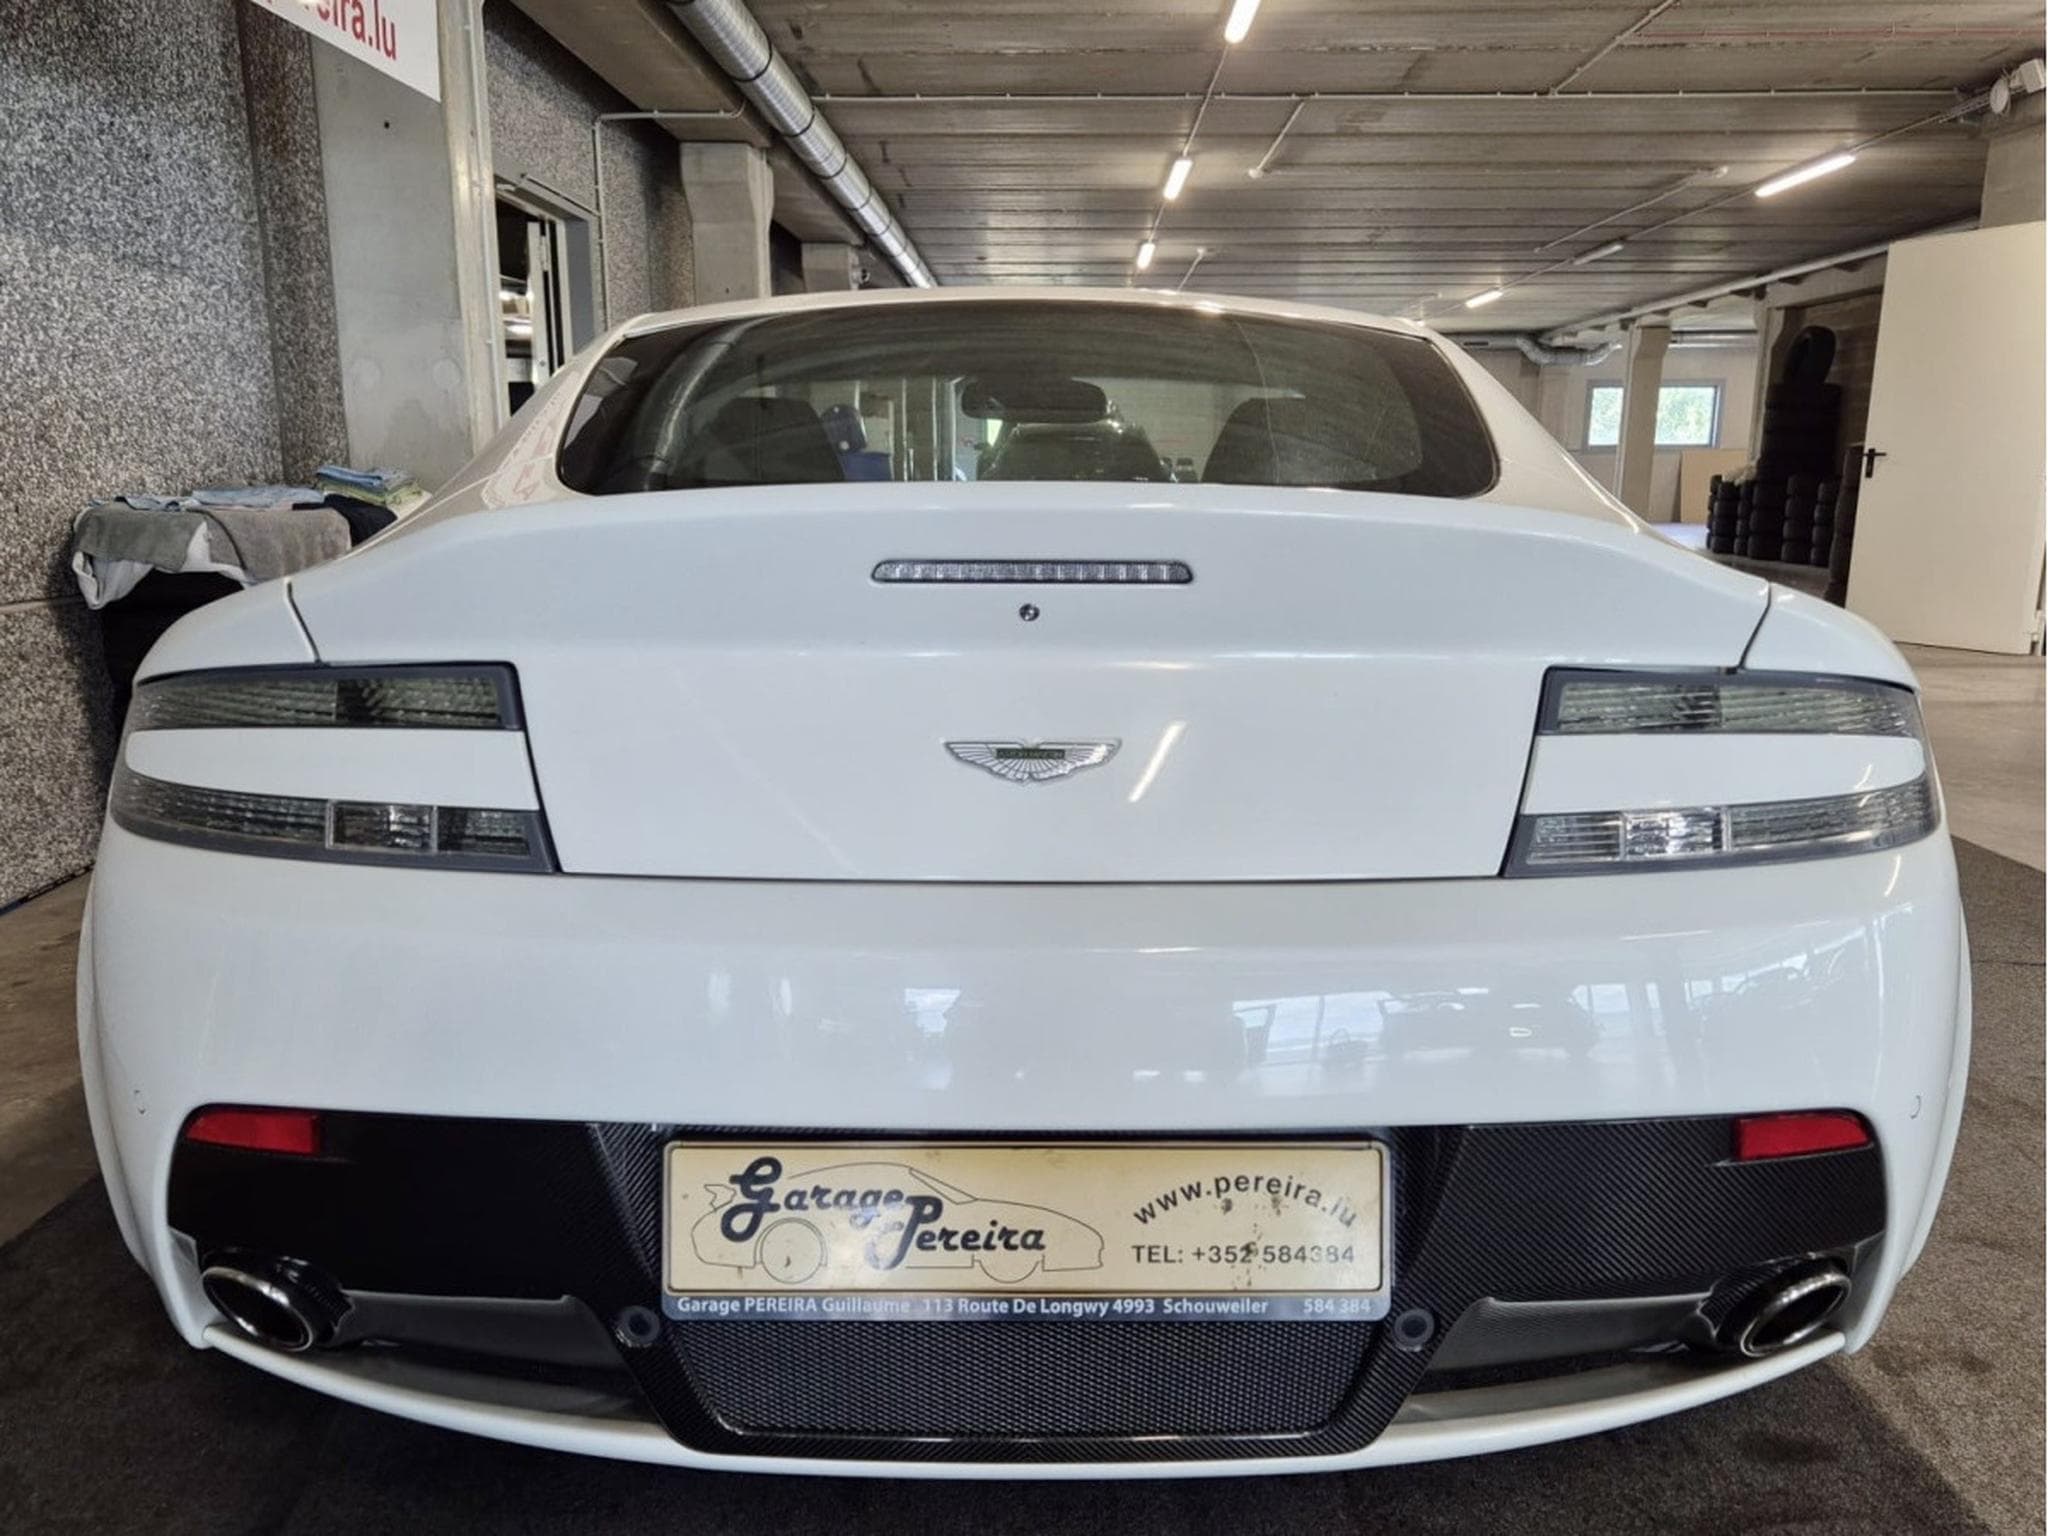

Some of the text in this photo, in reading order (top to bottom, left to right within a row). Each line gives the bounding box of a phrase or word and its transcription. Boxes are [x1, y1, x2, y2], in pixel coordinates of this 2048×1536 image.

[721, 1157, 904, 1242] Garage
[1133, 1174, 1358, 1228] www.pereira.lu
[865, 1196, 1045, 1270] Pereira
[1131, 1244, 1355, 1264] TEL: +352 584384
[677, 1296, 1371, 1317] Garage PEREIRA Guillaume 113 Route De Longwy 4993 Schouweiler 584 384
